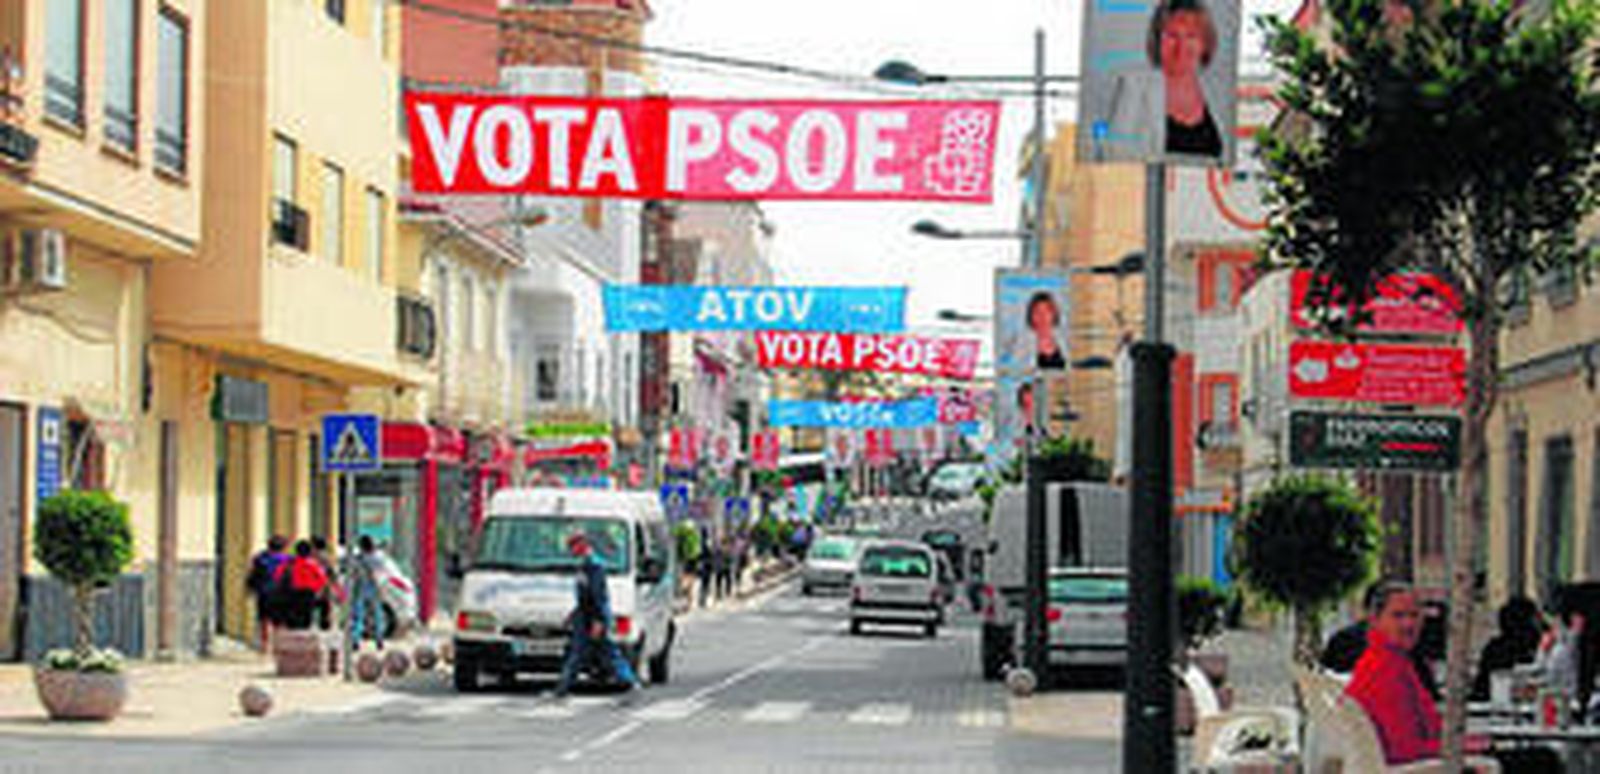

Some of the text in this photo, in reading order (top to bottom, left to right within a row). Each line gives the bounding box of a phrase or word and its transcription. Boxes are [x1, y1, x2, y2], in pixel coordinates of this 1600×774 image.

[414, 103, 909, 194] VOTA PSOE
[760, 333, 942, 369] VOTA PSOE
